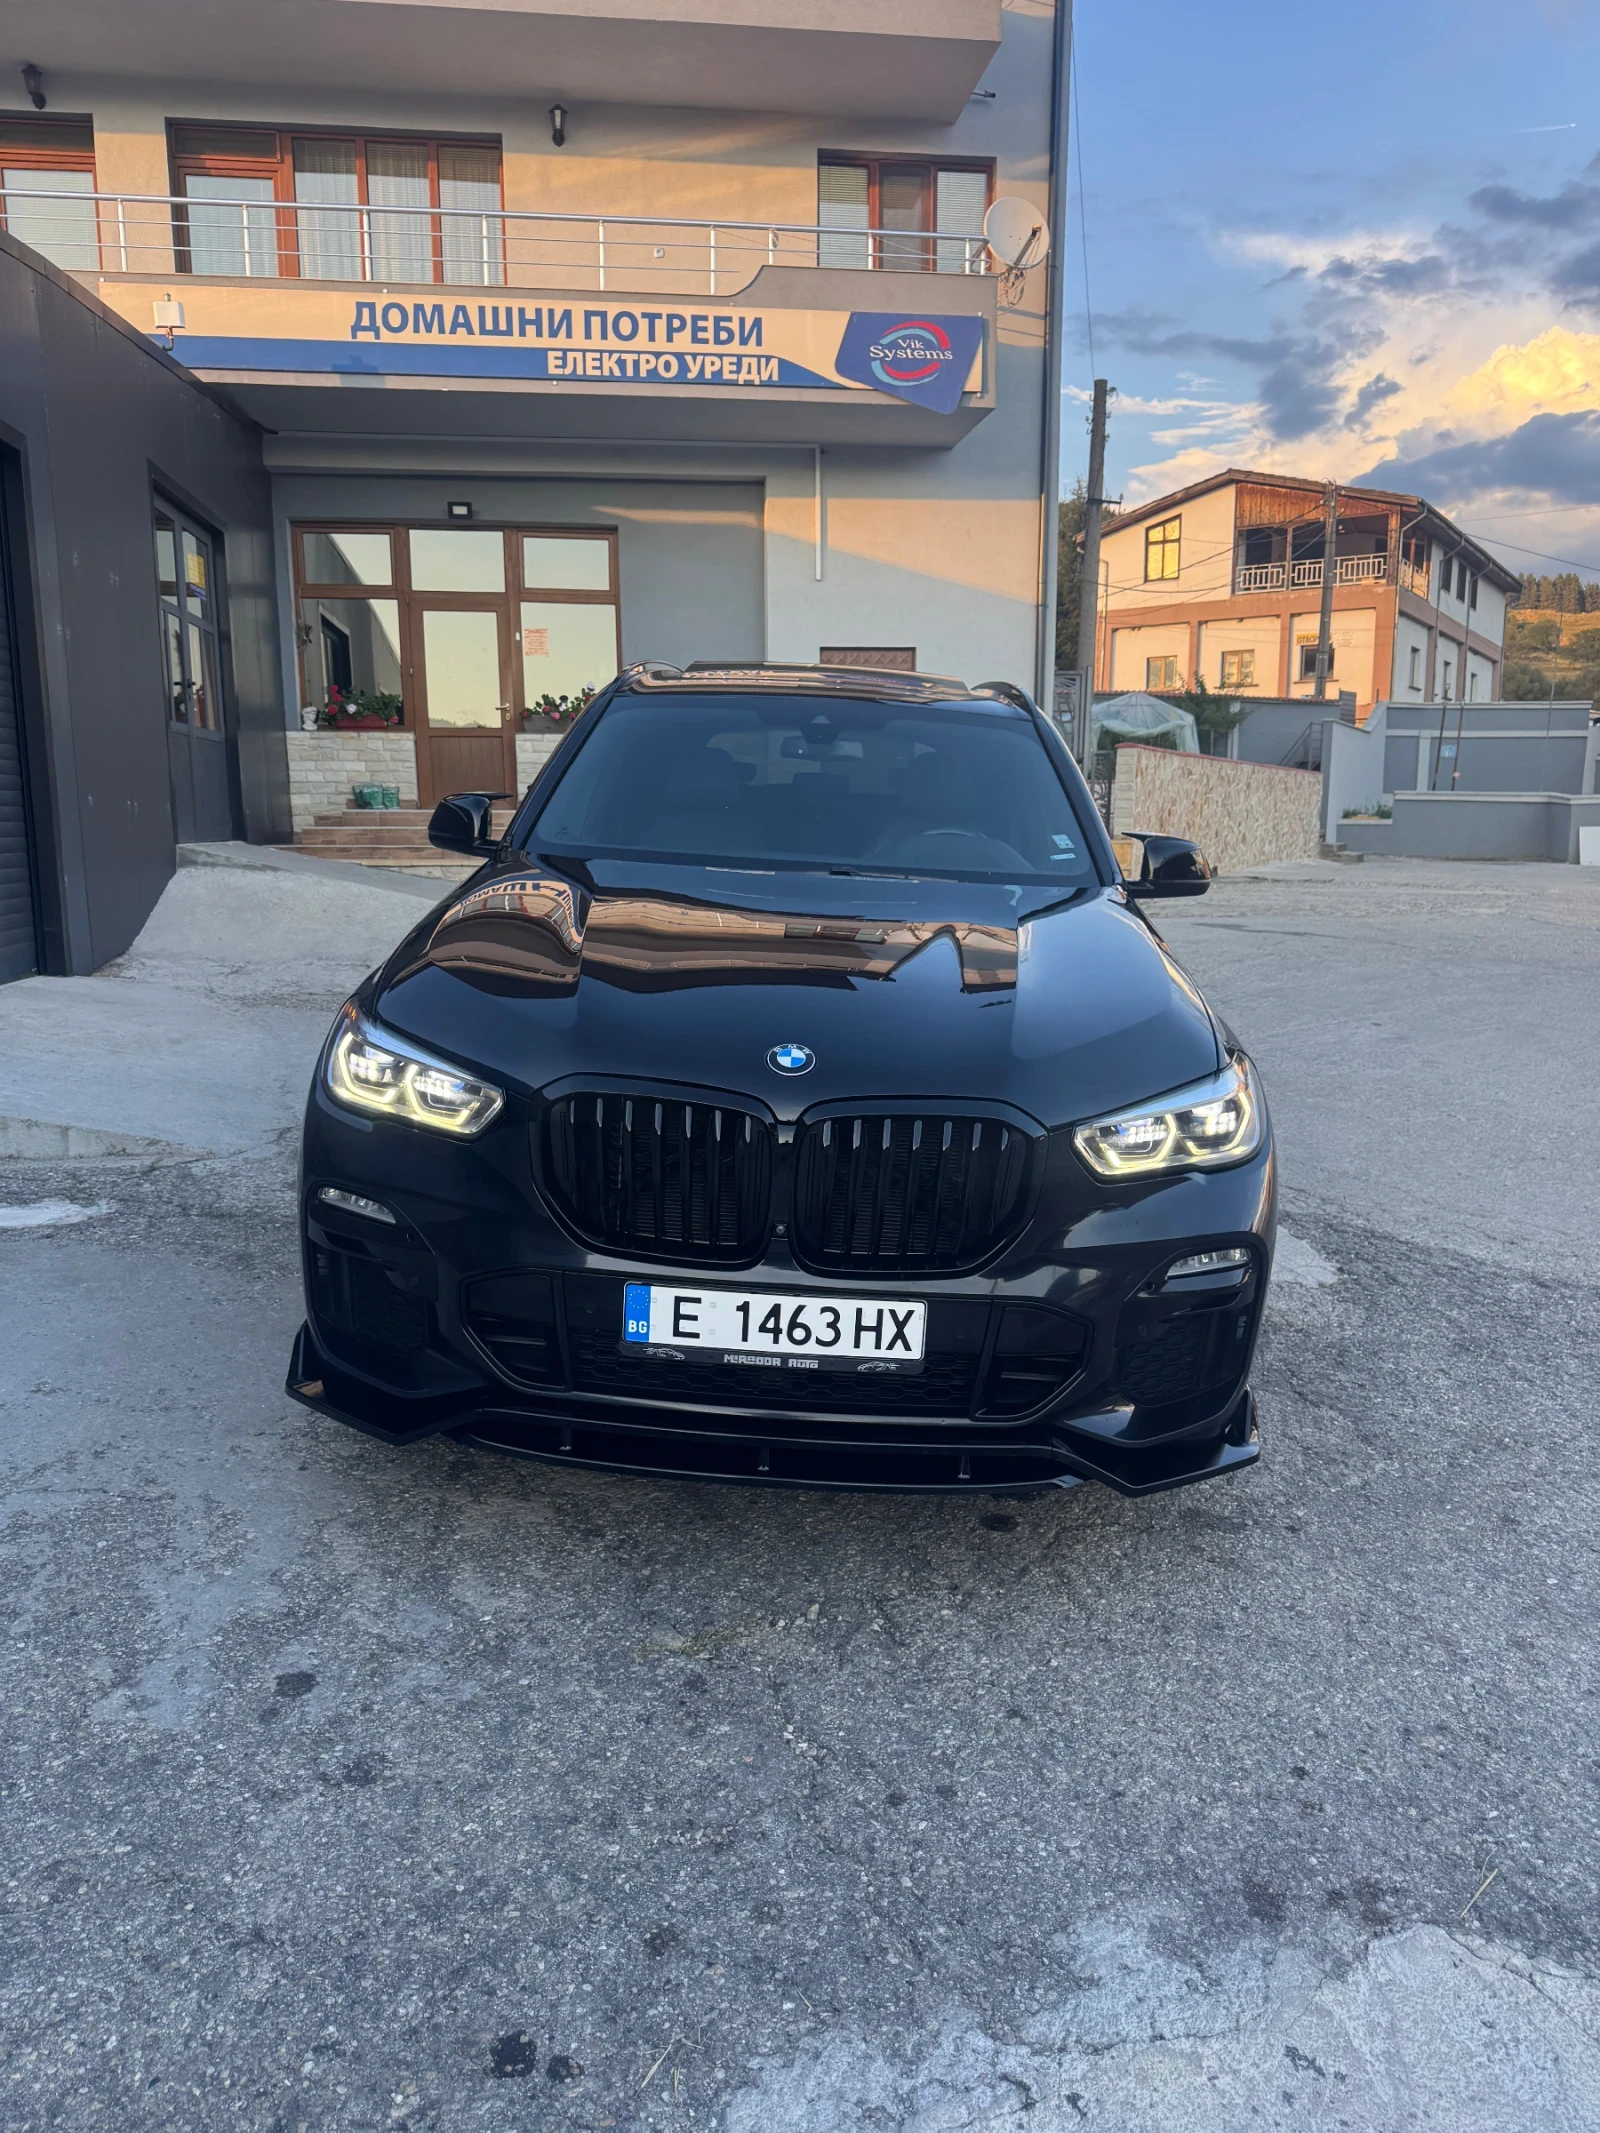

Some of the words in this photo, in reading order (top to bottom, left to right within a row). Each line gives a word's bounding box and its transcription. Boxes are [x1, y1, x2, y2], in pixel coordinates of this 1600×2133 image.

[350, 301, 573, 340] ДОМАШНИ
[583, 309, 763, 347] ПОТРЕБИ
[869, 345, 953, 361] Systems
[897, 339, 925, 349] Vik
[547, 350, 679, 379] ЕЛЕКТРО
[684, 354, 779, 385] УРЕДИ
[628, 1319, 648, 1333] BG
[672, 1295, 702, 1339] E
[735, 1300, 842, 1348] 1463
[853, 1307, 915, 1351] HX
